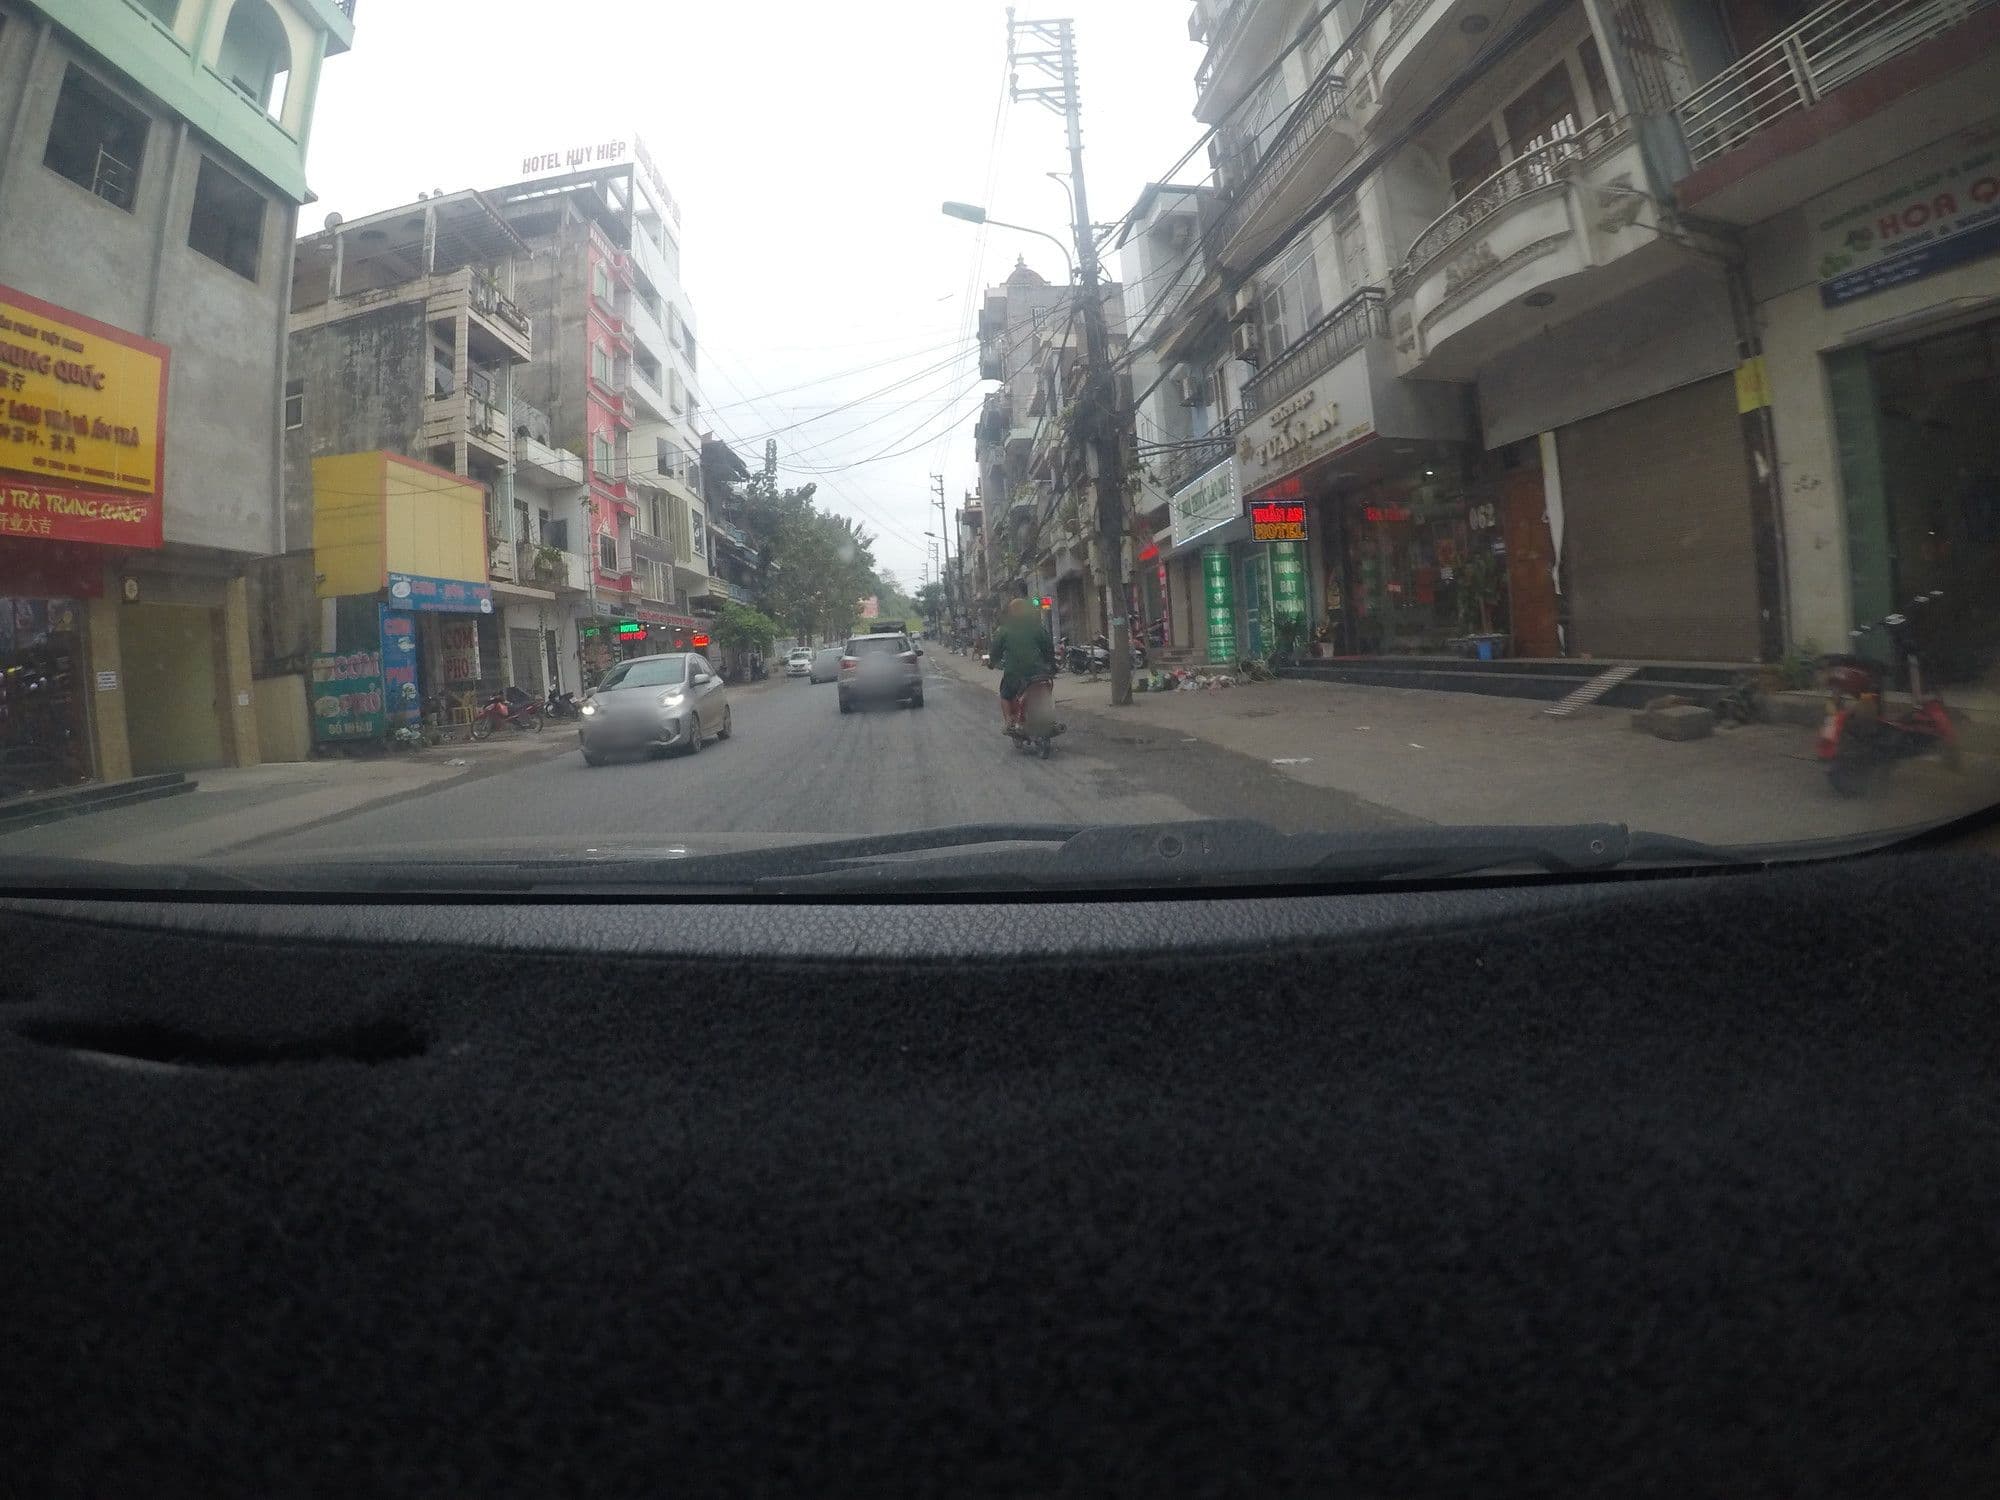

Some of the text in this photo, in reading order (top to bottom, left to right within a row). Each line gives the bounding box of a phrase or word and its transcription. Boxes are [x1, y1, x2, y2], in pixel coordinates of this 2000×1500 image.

[522, 139, 626, 175] HOTEL HUY HIỆP
[0, 341, 105, 392] RUNG QUỐC
[1255, 419, 1306, 466] TUẤN
[1307, 399, 1338, 440] AN
[10, 486, 41, 511] TRÀ
[45, 494, 97, 518] TRUNG
[1253, 503, 1303, 523] TUẤN AN
[1254, 522, 1305, 540] HOTEL
[620, 624, 640, 633] HOTEL
